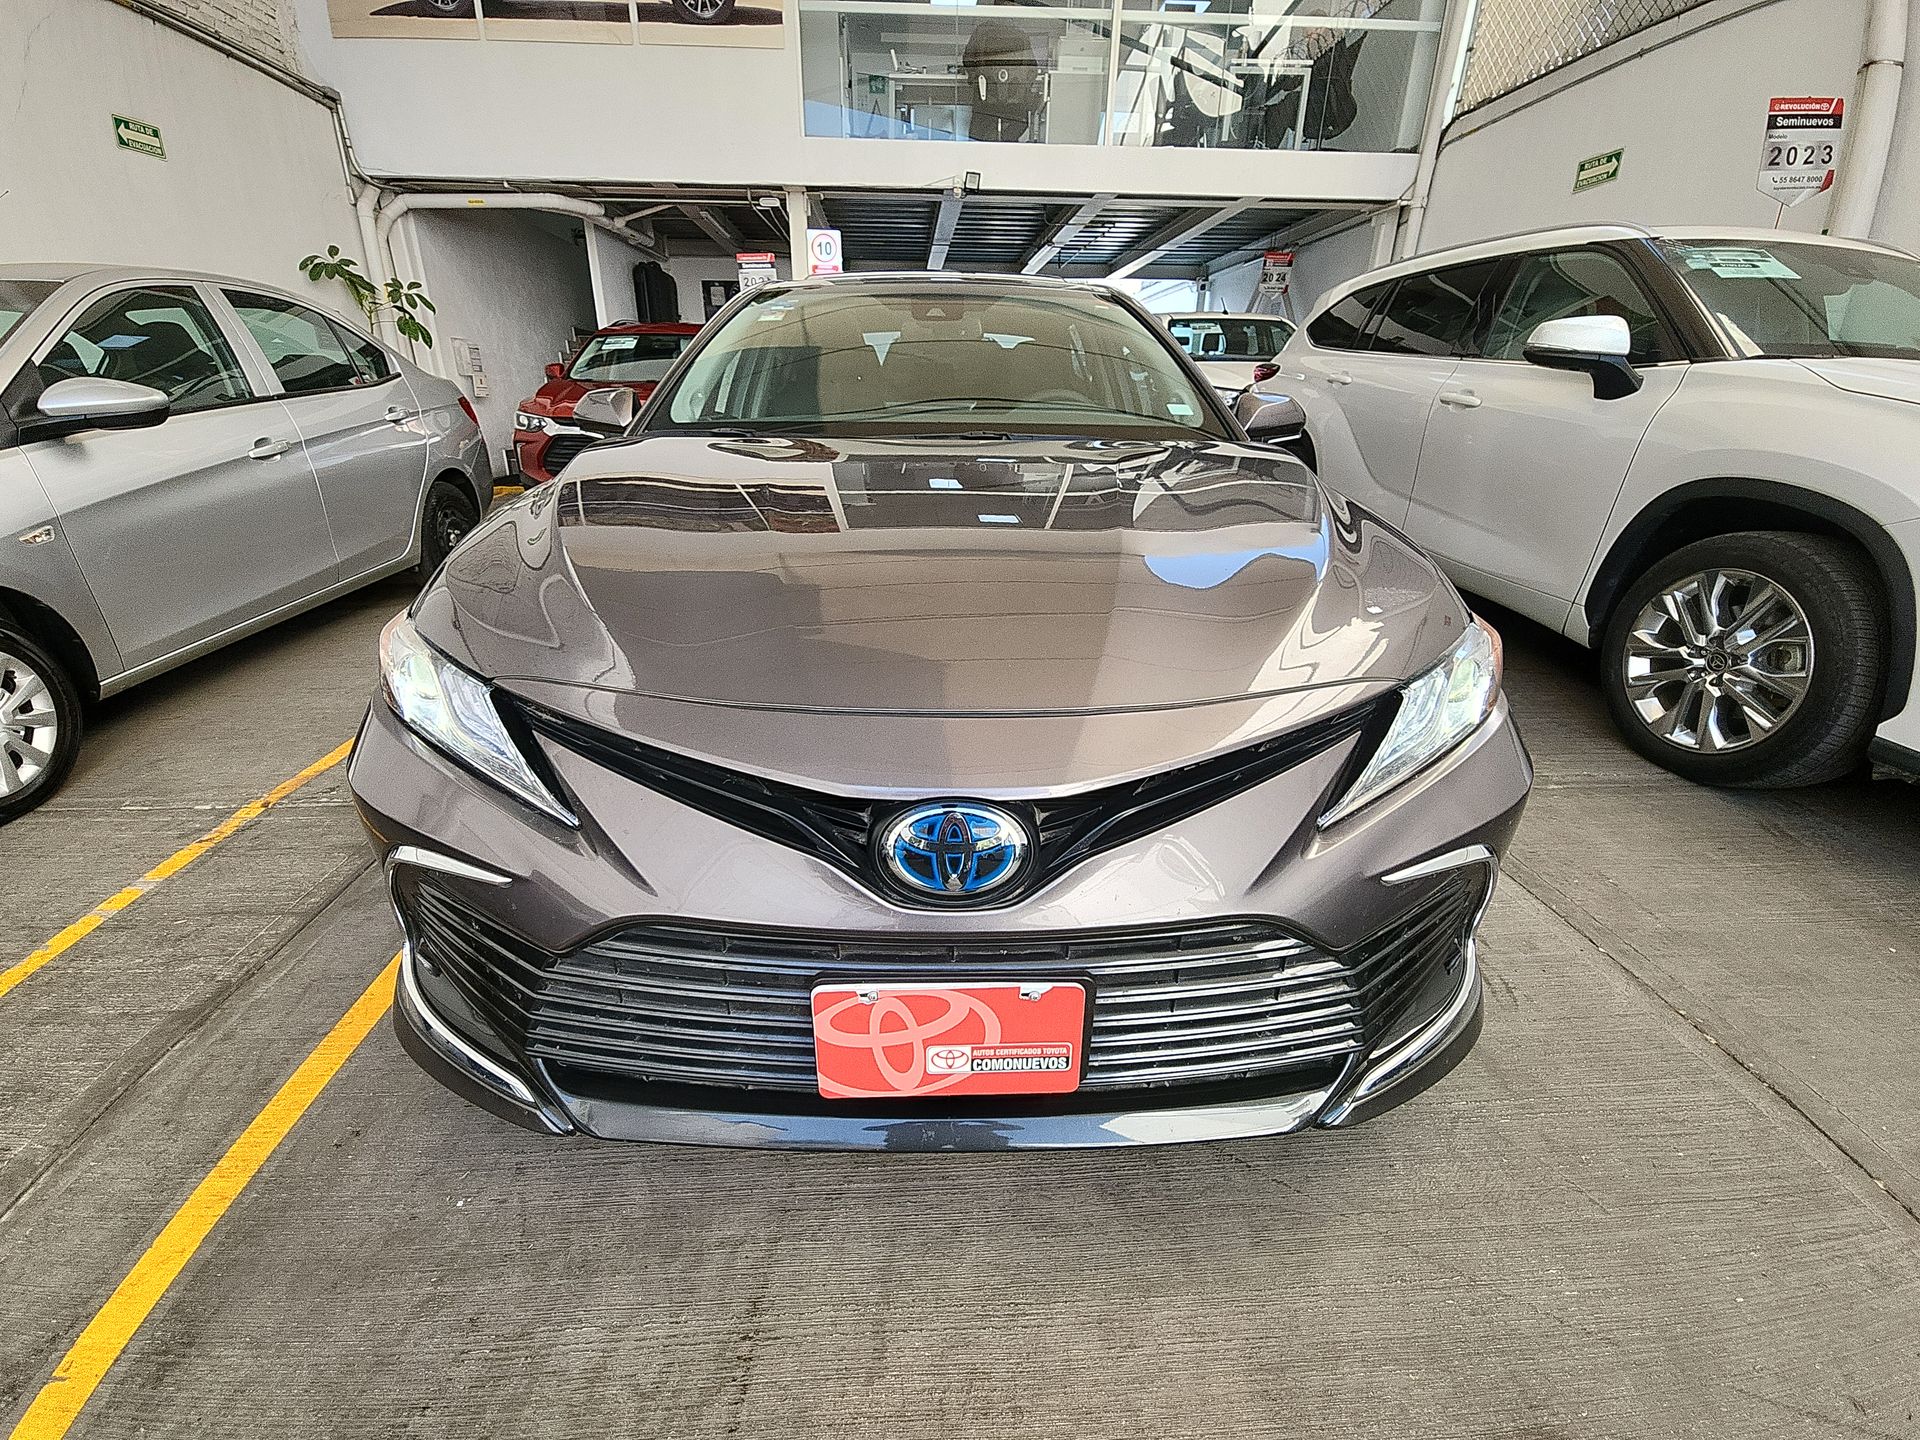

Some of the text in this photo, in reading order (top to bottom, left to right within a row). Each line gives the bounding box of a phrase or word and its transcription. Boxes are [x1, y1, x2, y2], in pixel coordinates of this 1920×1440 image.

[1776, 116, 1834, 127] Seminuevos
[128, 122, 154, 136] RUTA DE
[1768, 144, 1834, 167] 2023
[1584, 156, 1608, 170] RUTA DE
[1806, 175, 1823, 183] 8000
[817, 241, 832, 256] 10
[1263, 272, 1287, 282] 2024
[972, 1047, 1067, 1057] AUTOS CERTIFICADOS TOYOTA
[972, 1056, 1067, 1071] COMONUEVOS
